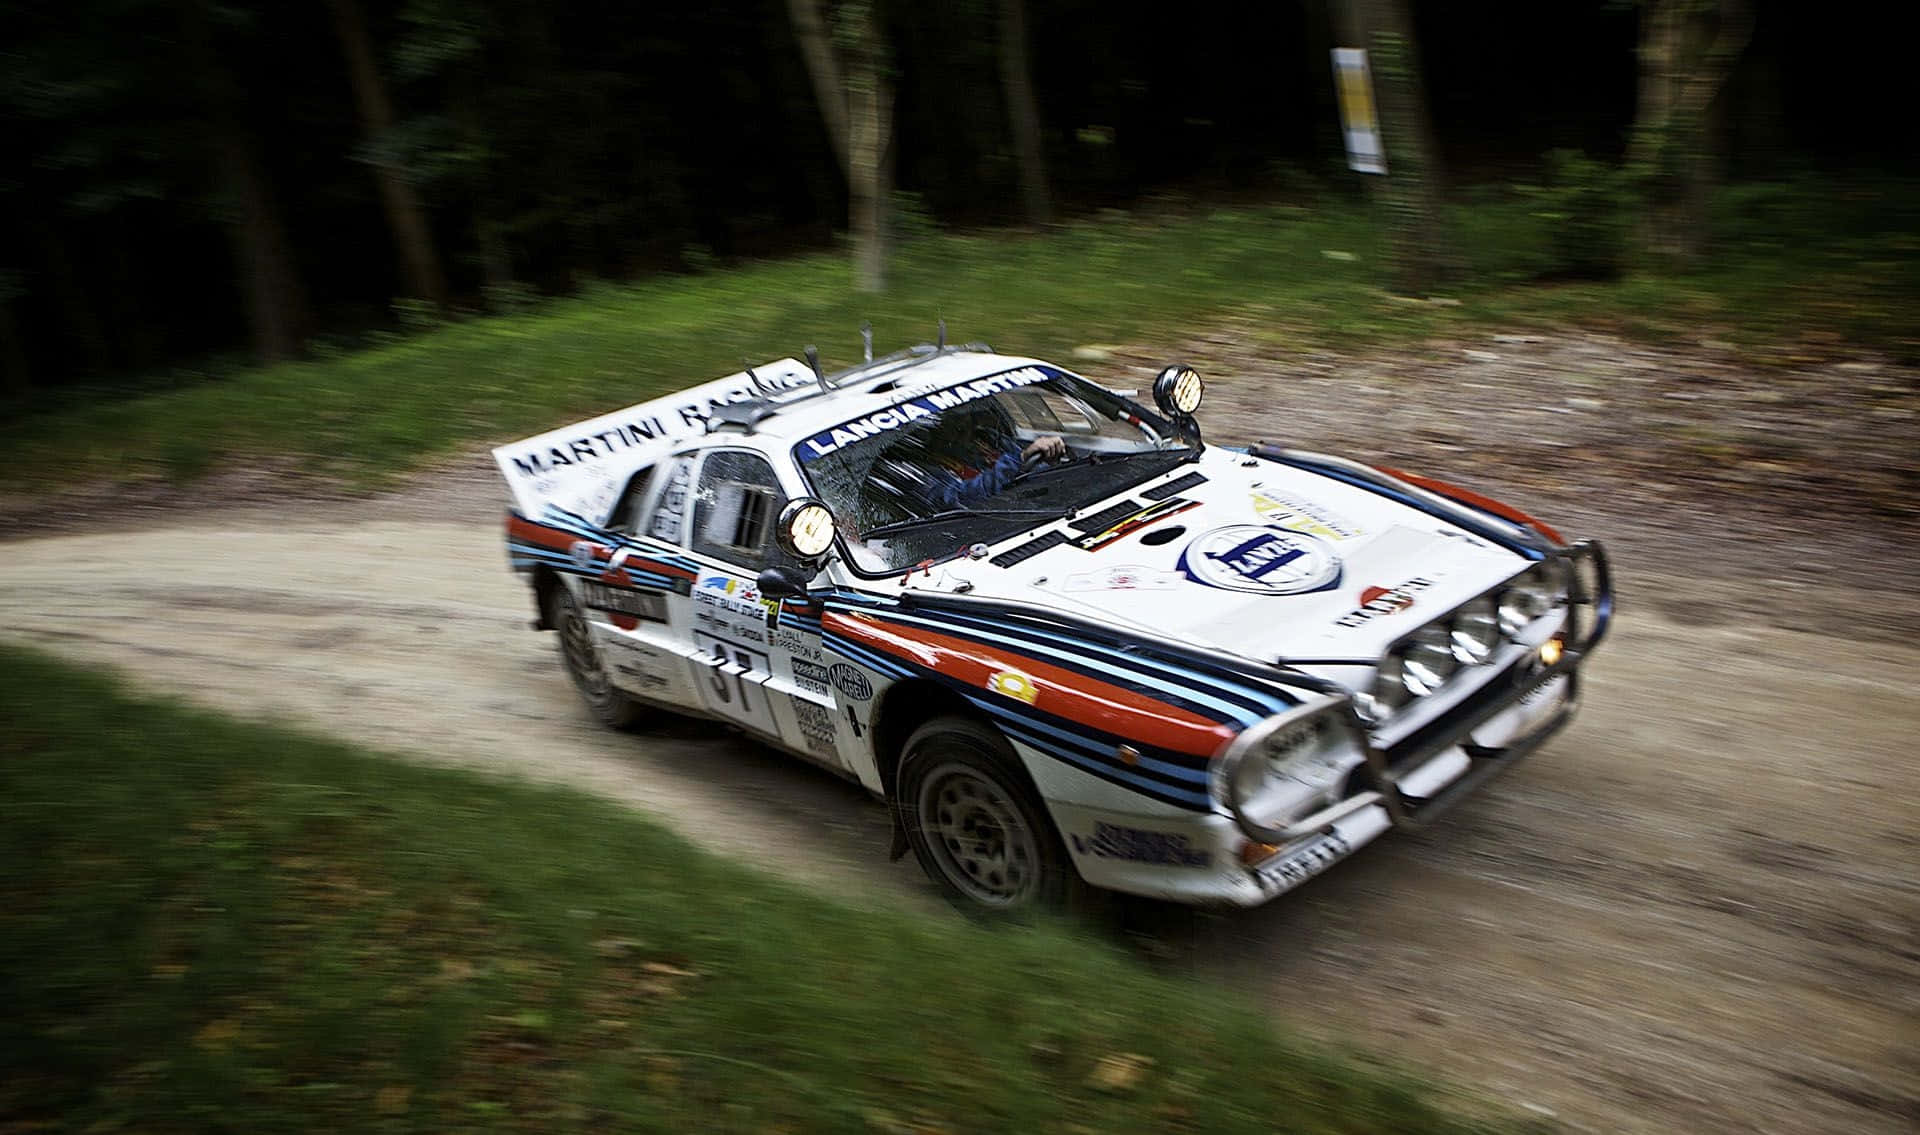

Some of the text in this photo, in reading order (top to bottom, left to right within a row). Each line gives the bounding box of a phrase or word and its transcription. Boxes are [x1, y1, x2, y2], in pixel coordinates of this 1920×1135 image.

[512, 416, 667, 474] MARTINI
[806, 366, 1048, 456] LANCIA MARTINI
